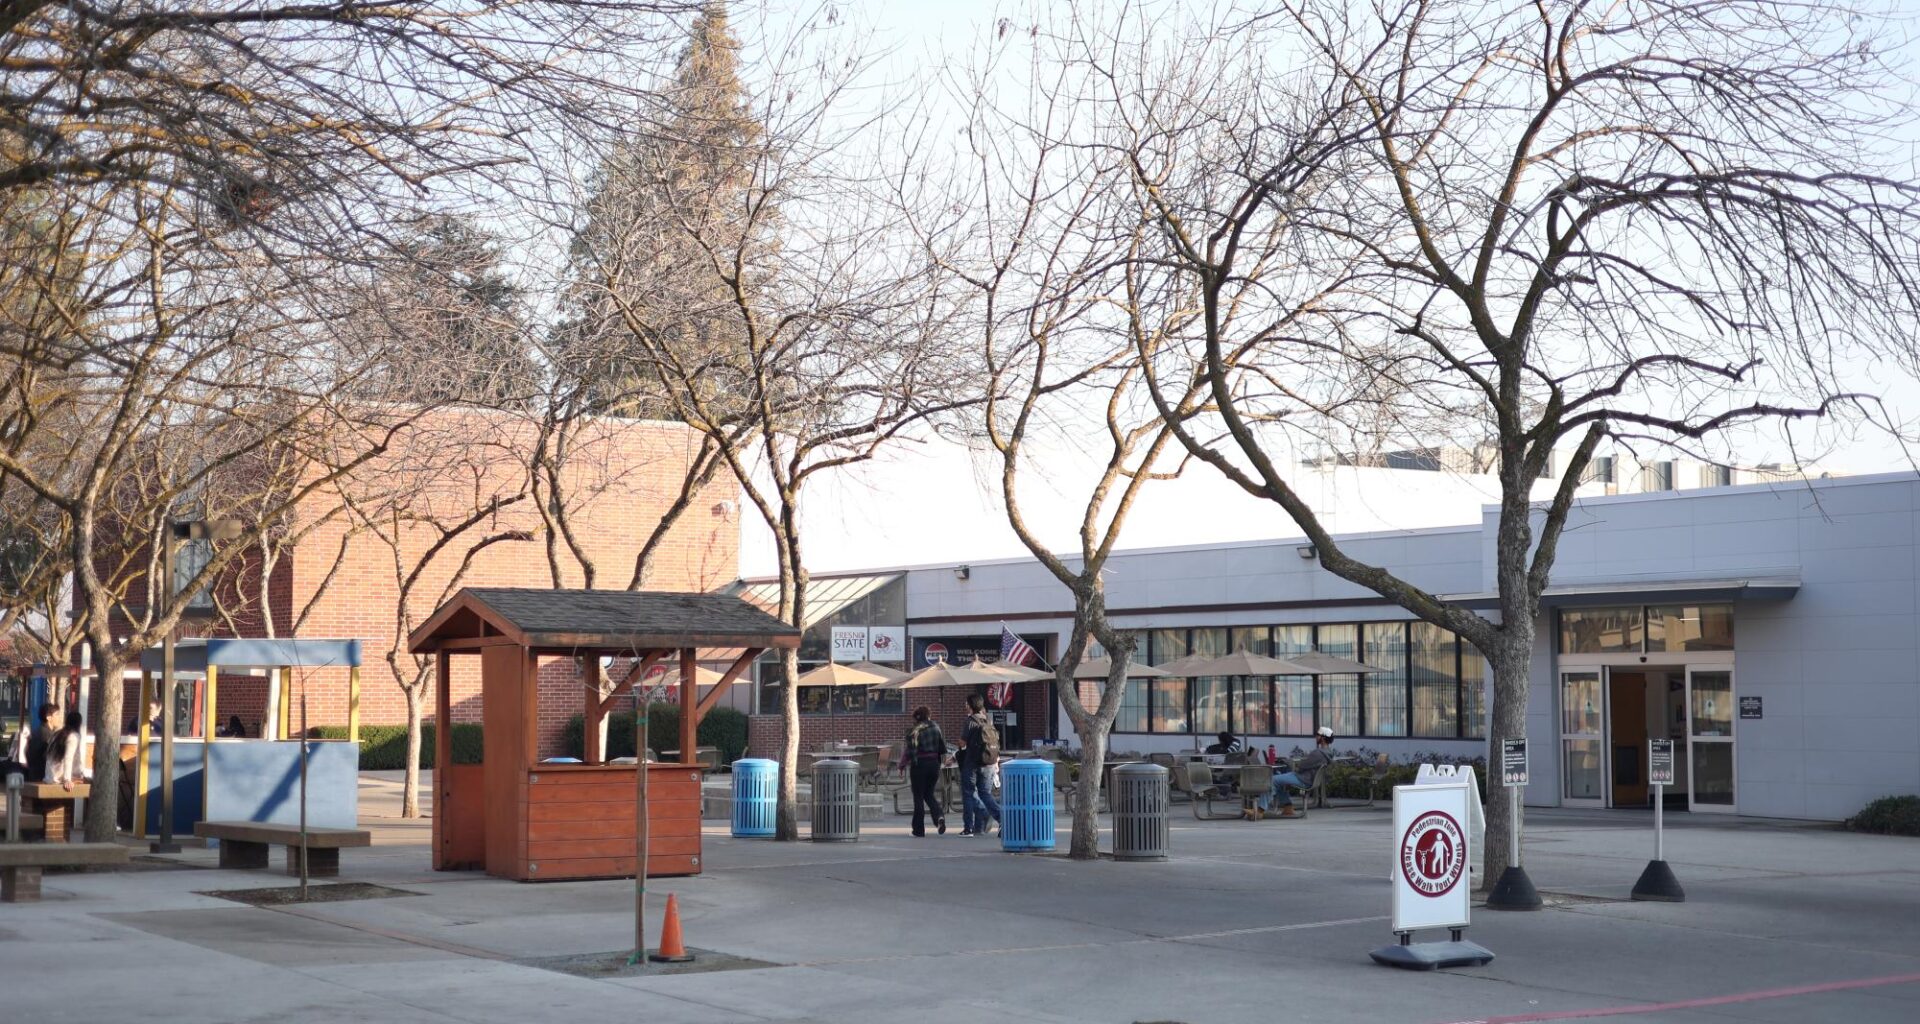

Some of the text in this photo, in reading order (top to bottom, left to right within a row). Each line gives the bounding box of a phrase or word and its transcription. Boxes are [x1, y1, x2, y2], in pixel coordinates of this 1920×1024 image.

[834, 639, 865, 649] STATE
[1412, 817, 1457, 838] Pedestrian Zone
[1406, 842, 1462, 891] Please Walk Your Wheels
